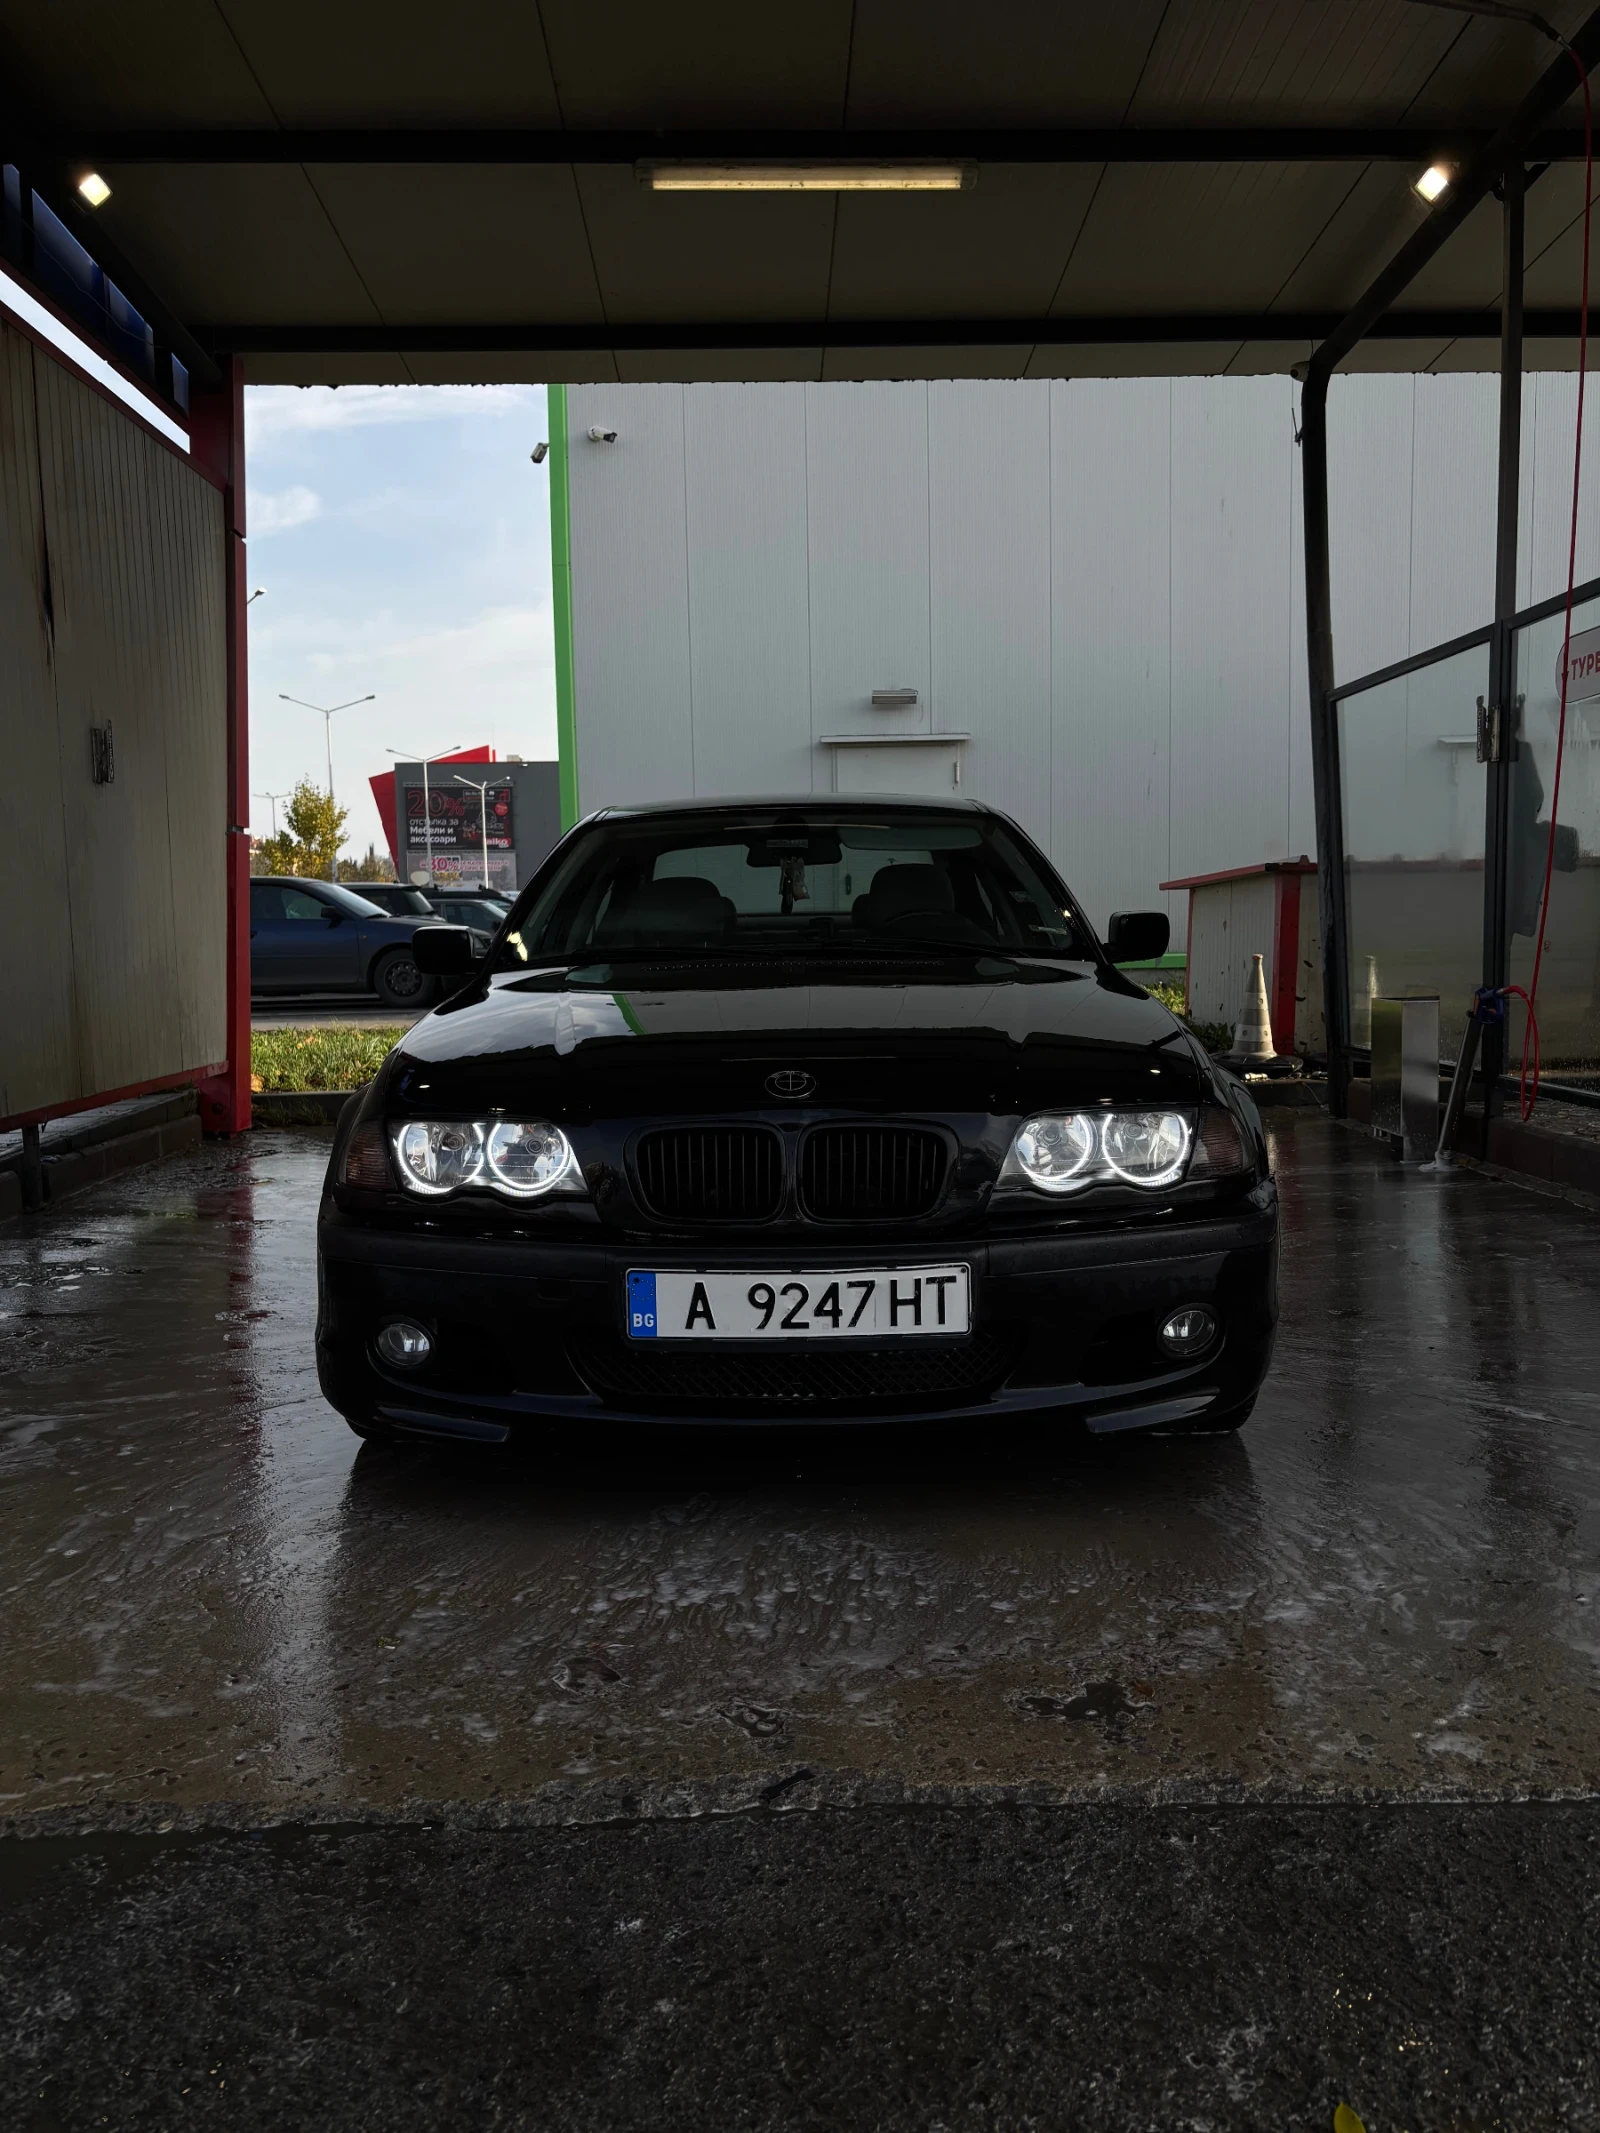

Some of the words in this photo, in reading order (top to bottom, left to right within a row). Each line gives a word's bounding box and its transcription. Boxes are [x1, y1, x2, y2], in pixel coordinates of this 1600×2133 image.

[407, 790, 465, 817] 20%
[410, 826, 446, 835] Мебели
[447, 827, 454, 835] и
[685, 1281, 716, 1330] A
[747, 1279, 877, 1330] 9247
[889, 1275, 957, 1327] HT
[632, 1313, 655, 1328] BG
